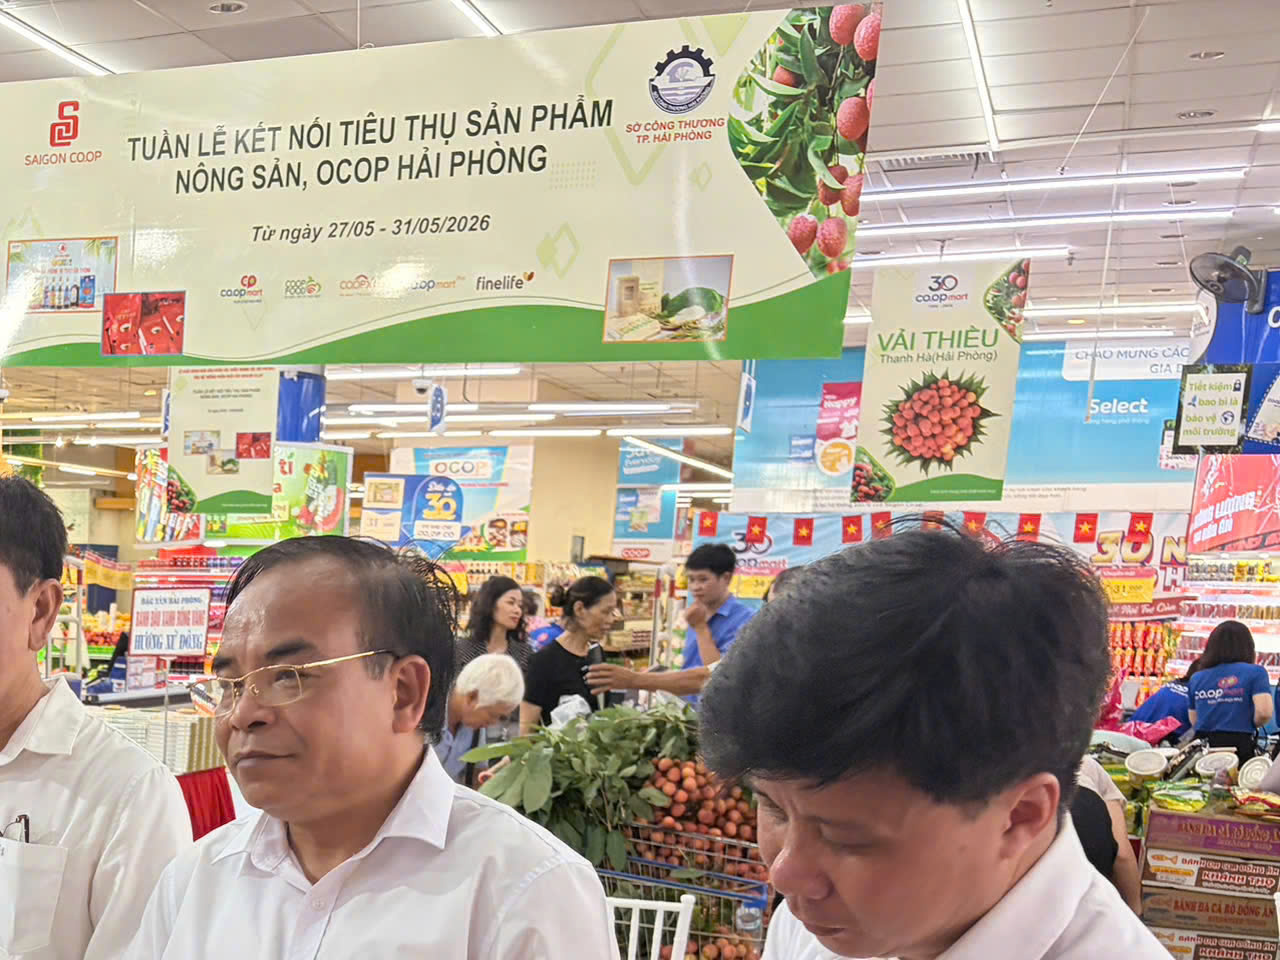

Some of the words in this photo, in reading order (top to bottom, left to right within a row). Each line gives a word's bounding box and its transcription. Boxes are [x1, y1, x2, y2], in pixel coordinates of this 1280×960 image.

[128, 129, 190, 162] TUẦN
[198, 125, 227, 158] LỄ
[234, 121, 282, 154] KẾT
[289, 116, 331, 151] NỐI
[339, 112, 396, 146] TIÊU
[405, 109, 458, 146] THỤ
[465, 102, 522, 138] SẢN
[530, 93, 613, 132] PHẨM
[643, 119, 675, 132] CÔNG
[678, 117, 726, 129] THƯƠNG
[636, 134, 651, 144] TP.
[653, 132, 672, 143] HẢI
[673, 129, 713, 142] PHÒNG
[24, 151, 66, 166] SAIGON
[175, 165, 244, 194] NÔNG
[252, 158, 308, 191] SẢN,
[316, 155, 389, 186] OCOP
[397, 147, 440, 180] HẢI
[449, 141, 548, 177] PHÒNG
[251, 225, 275, 243] Từ
[279, 224, 322, 246] ngày
[327, 219, 376, 240] 27/05
[391, 214, 491, 237] 31/05/2026
[475, 275, 524, 291] finelife
[928, 274, 958, 292] 30
[877, 327, 918, 353] VẢI
[922, 327, 1000, 350] THIỀU
[879, 352, 915, 365] Thanh
[957, 348, 999, 363] Phòng)
[1089, 397, 1149, 415] Select
[422, 492, 457, 521] 30
[1201, 870, 1246, 885] KHÁNH
